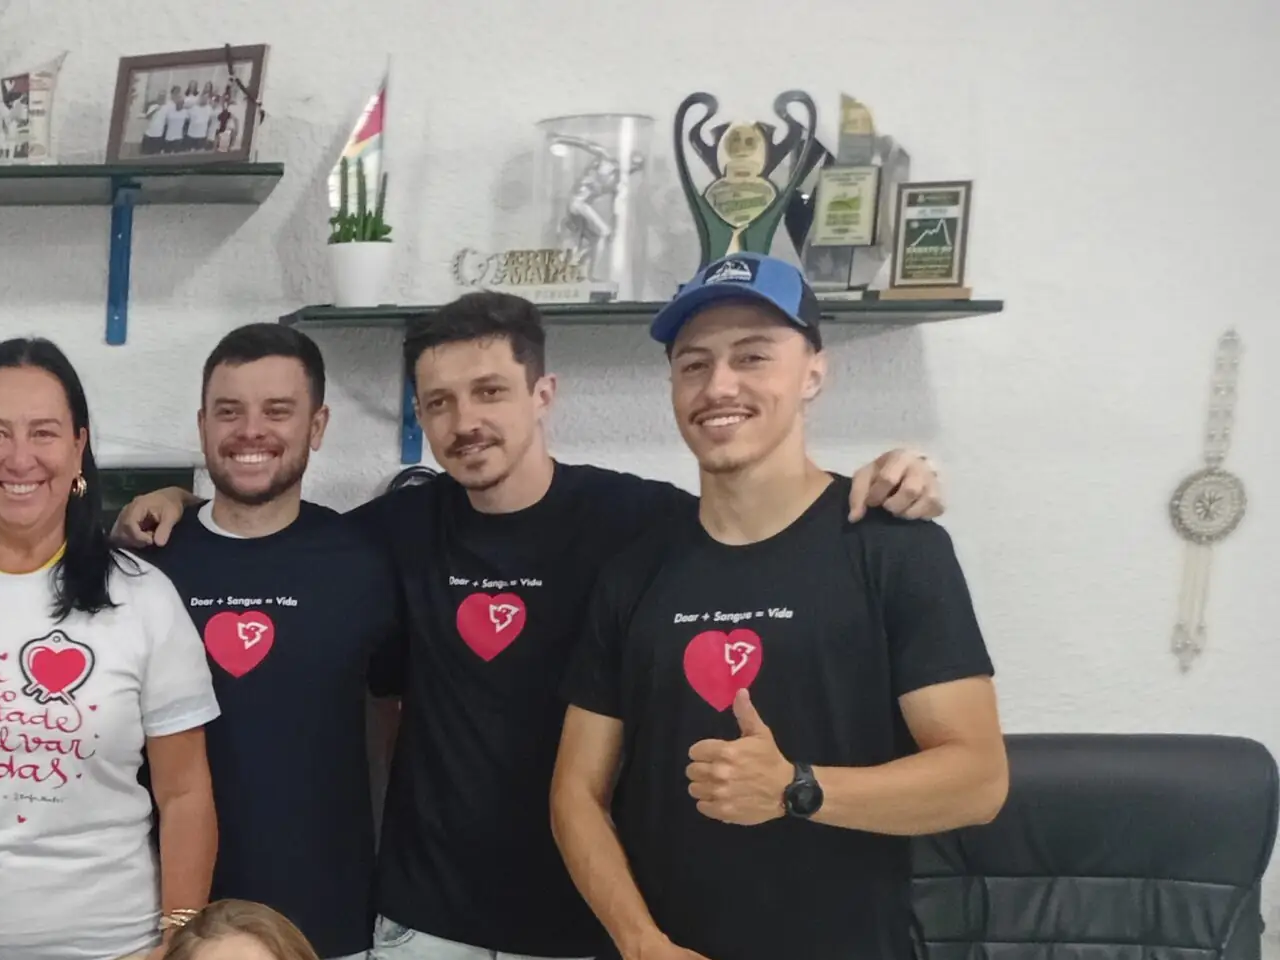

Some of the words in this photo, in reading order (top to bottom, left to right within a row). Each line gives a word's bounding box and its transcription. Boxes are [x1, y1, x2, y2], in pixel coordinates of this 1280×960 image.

[449, 576, 470, 585] Doar
[520, 578, 543, 587] Vida
[190, 597, 214, 606] Doar
[227, 596, 262, 607] Sangue
[276, 596, 298, 606] Vida
[674, 613, 699, 623] Doar
[713, 611, 753, 623] Sangue
[767, 606, 794, 619] Vida
